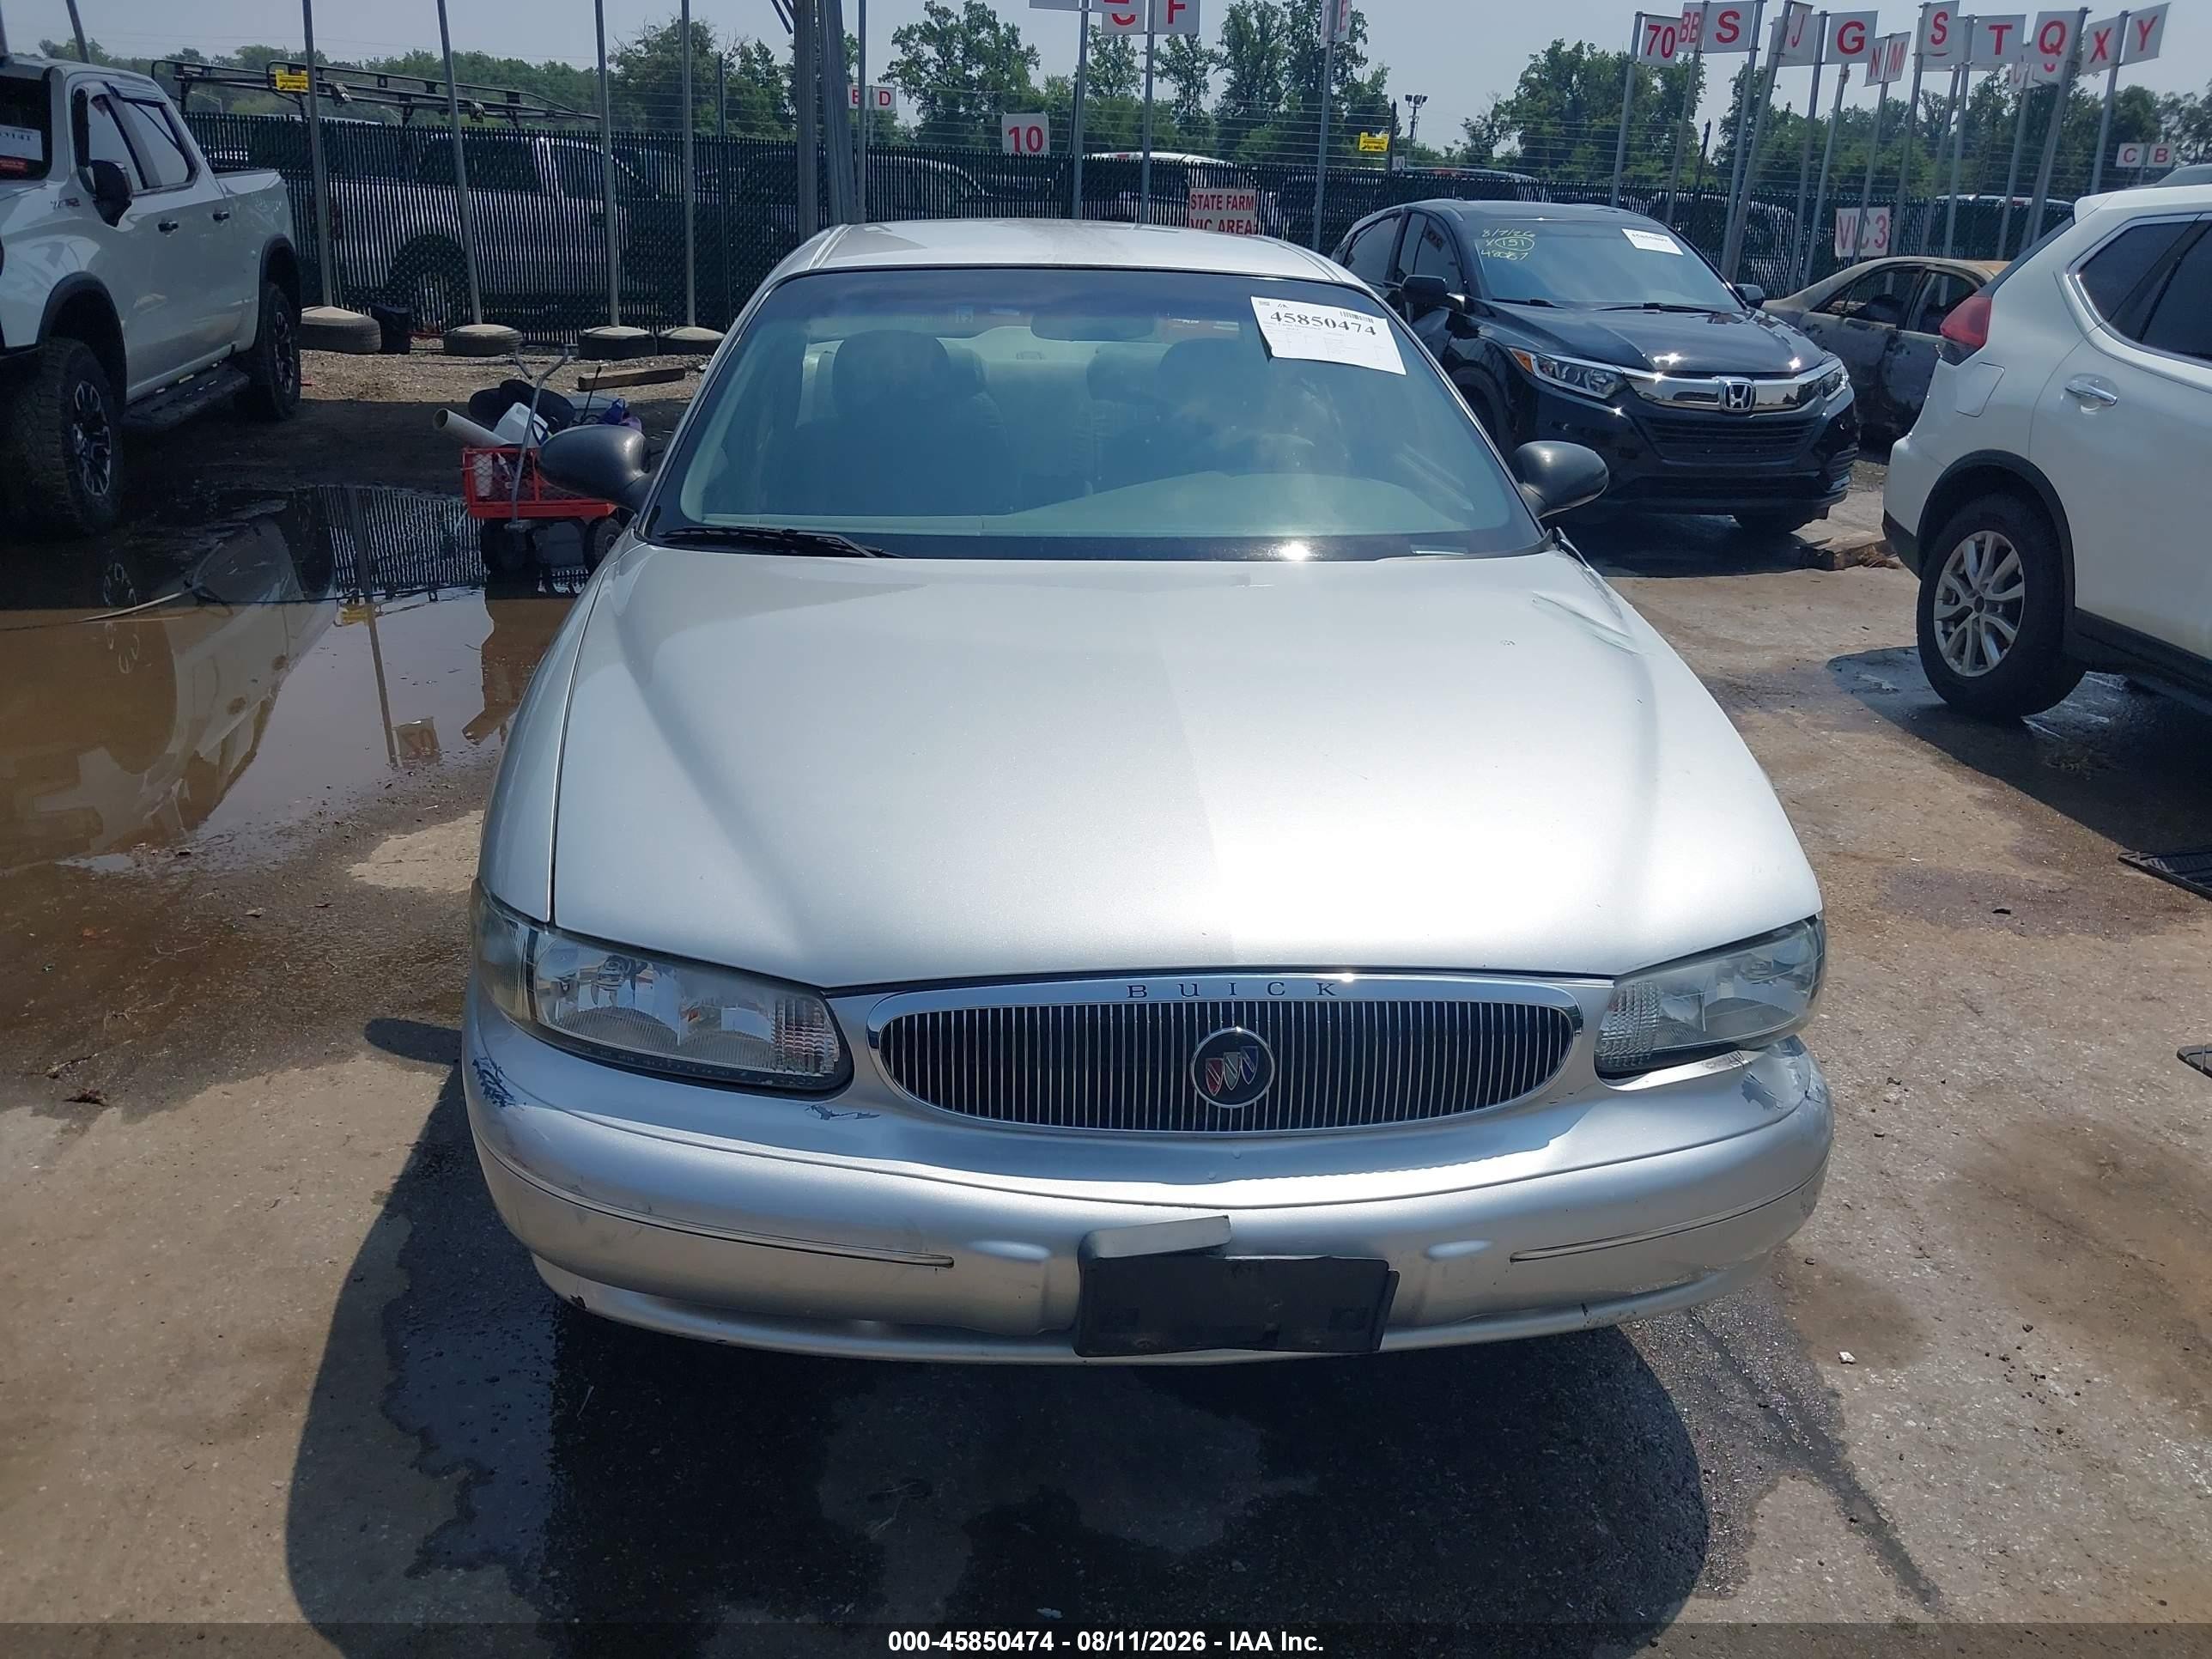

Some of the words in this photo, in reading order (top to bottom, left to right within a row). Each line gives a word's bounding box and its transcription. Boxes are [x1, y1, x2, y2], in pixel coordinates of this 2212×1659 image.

[1168, 0, 1185, 24] F
[1716, 10, 1740, 43] S
[1646, 25, 1675, 58] 70
[1838, 21, 1865, 55] G
[1931, 12, 1948, 45] S
[1988, 24, 2013, 55] T
[2039, 21, 2066, 57] Q
[2137, 15, 2158, 52] Y
[2089, 27, 2112, 64] X
[1869, 46, 1881, 77] N
[878, 90, 891, 106] D
[1008, 125, 1043, 154] 10
[2123, 148, 2136, 163] C
[2154, 148, 2168, 163] B
[1190, 194, 1223, 210] STATE
[1226, 195, 1254, 210] FARM
[1218, 219, 1252, 235] AREA
[1875, 215, 1887, 248] 3
[1270, 311, 1376, 336] 45850474
[1127, 981, 1336, 999] BUICK
